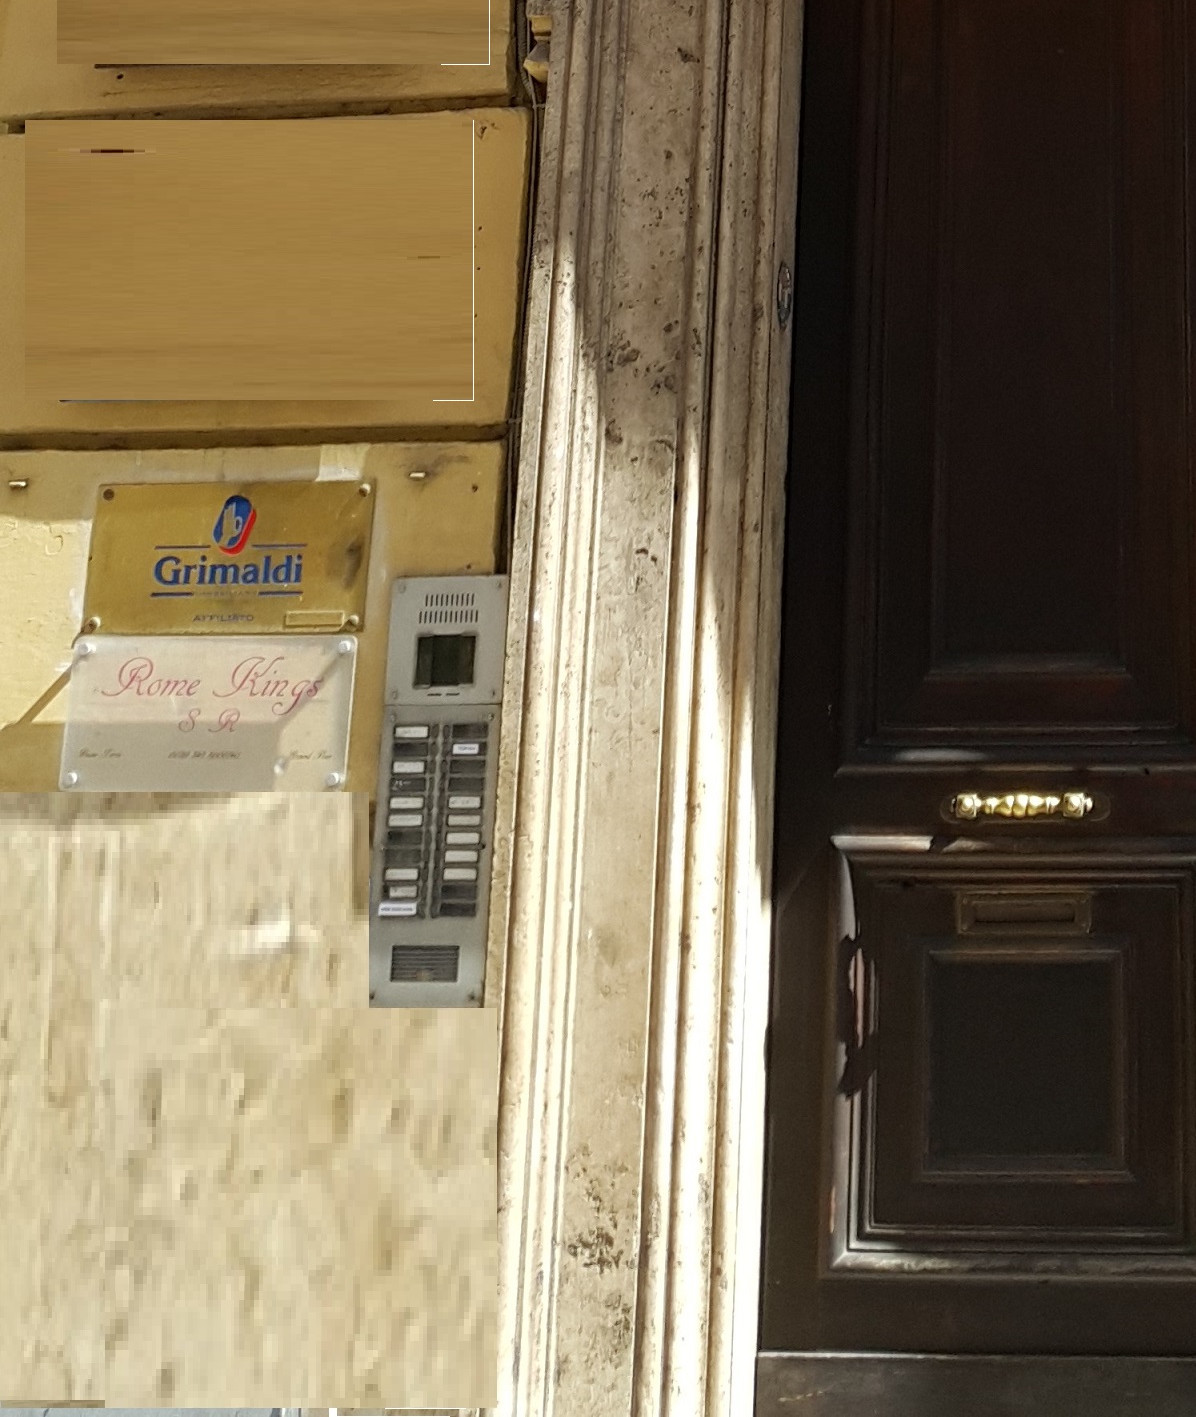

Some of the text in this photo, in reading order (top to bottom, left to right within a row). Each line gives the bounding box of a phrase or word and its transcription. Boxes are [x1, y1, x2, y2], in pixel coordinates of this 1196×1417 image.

[153, 554, 303, 586] Grimaldi
[101, 656, 325, 716] Rome Kings
